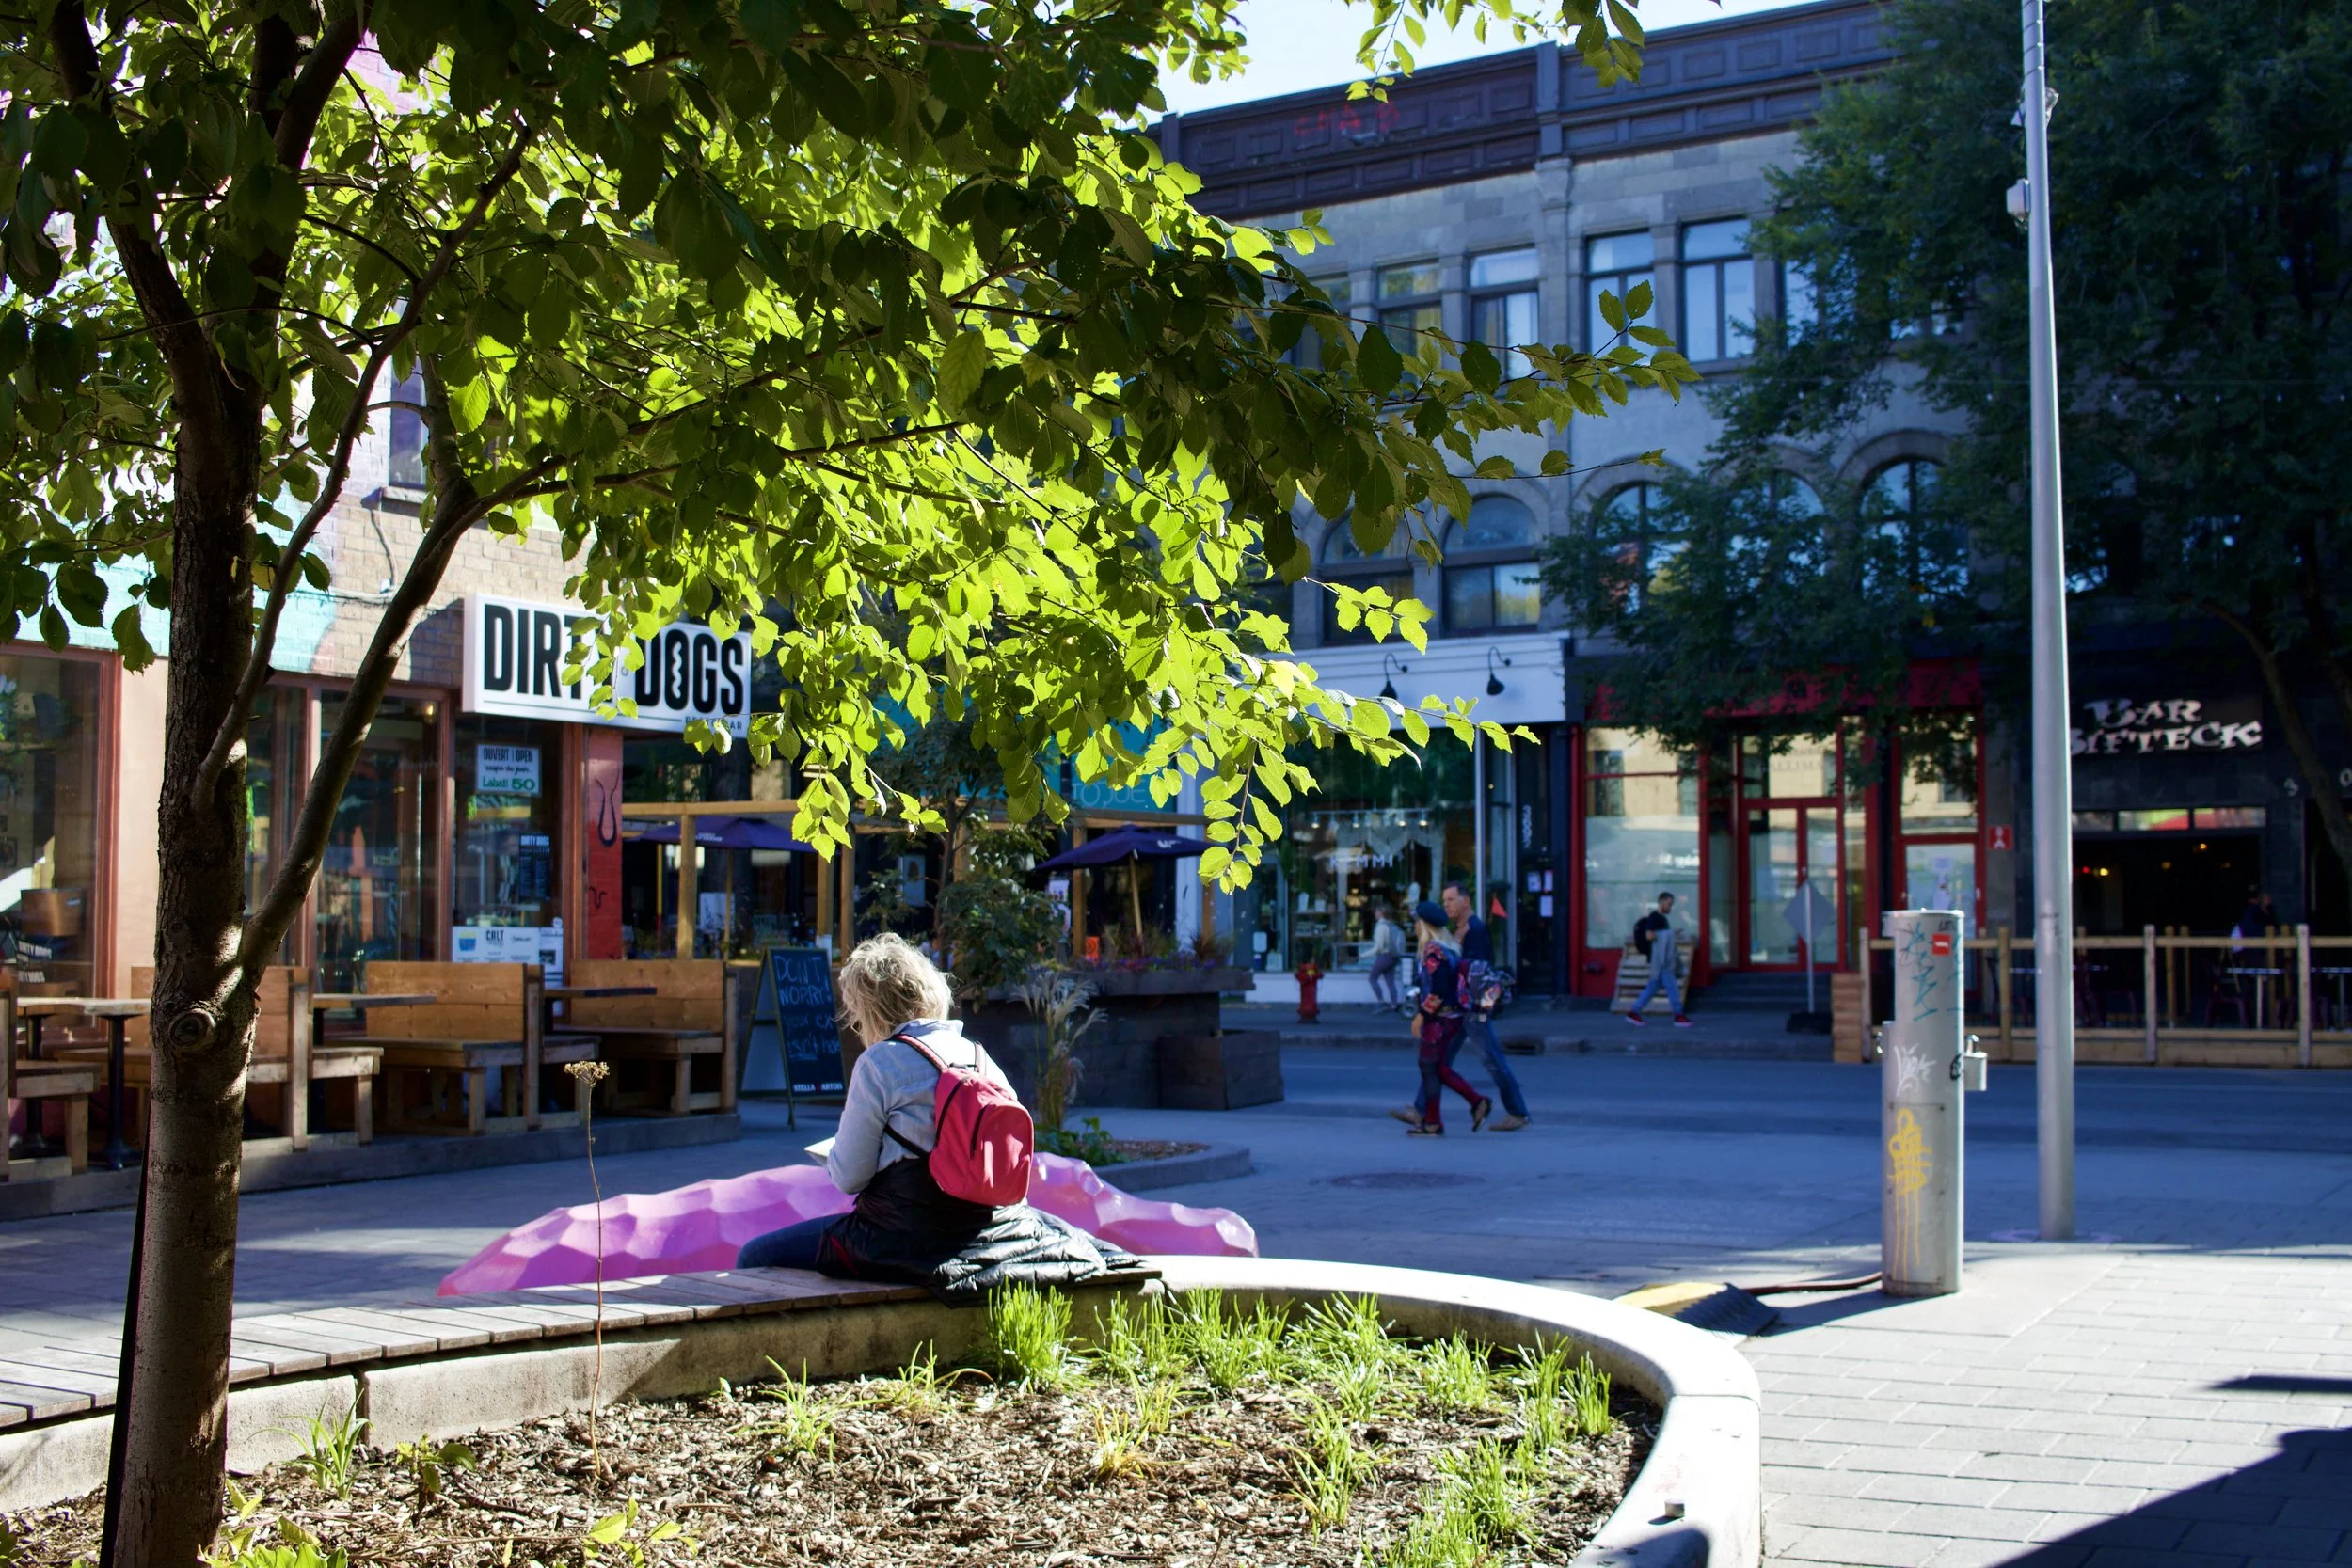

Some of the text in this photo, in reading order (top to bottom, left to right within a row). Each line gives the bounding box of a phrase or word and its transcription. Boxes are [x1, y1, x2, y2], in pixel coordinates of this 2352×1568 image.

[484, 604, 743, 714] DIRT DOGS
[2083, 698, 2202, 728] BAR
[483, 747, 533, 763] OUVERT OPEN
[511, 777, 536, 791] 50
